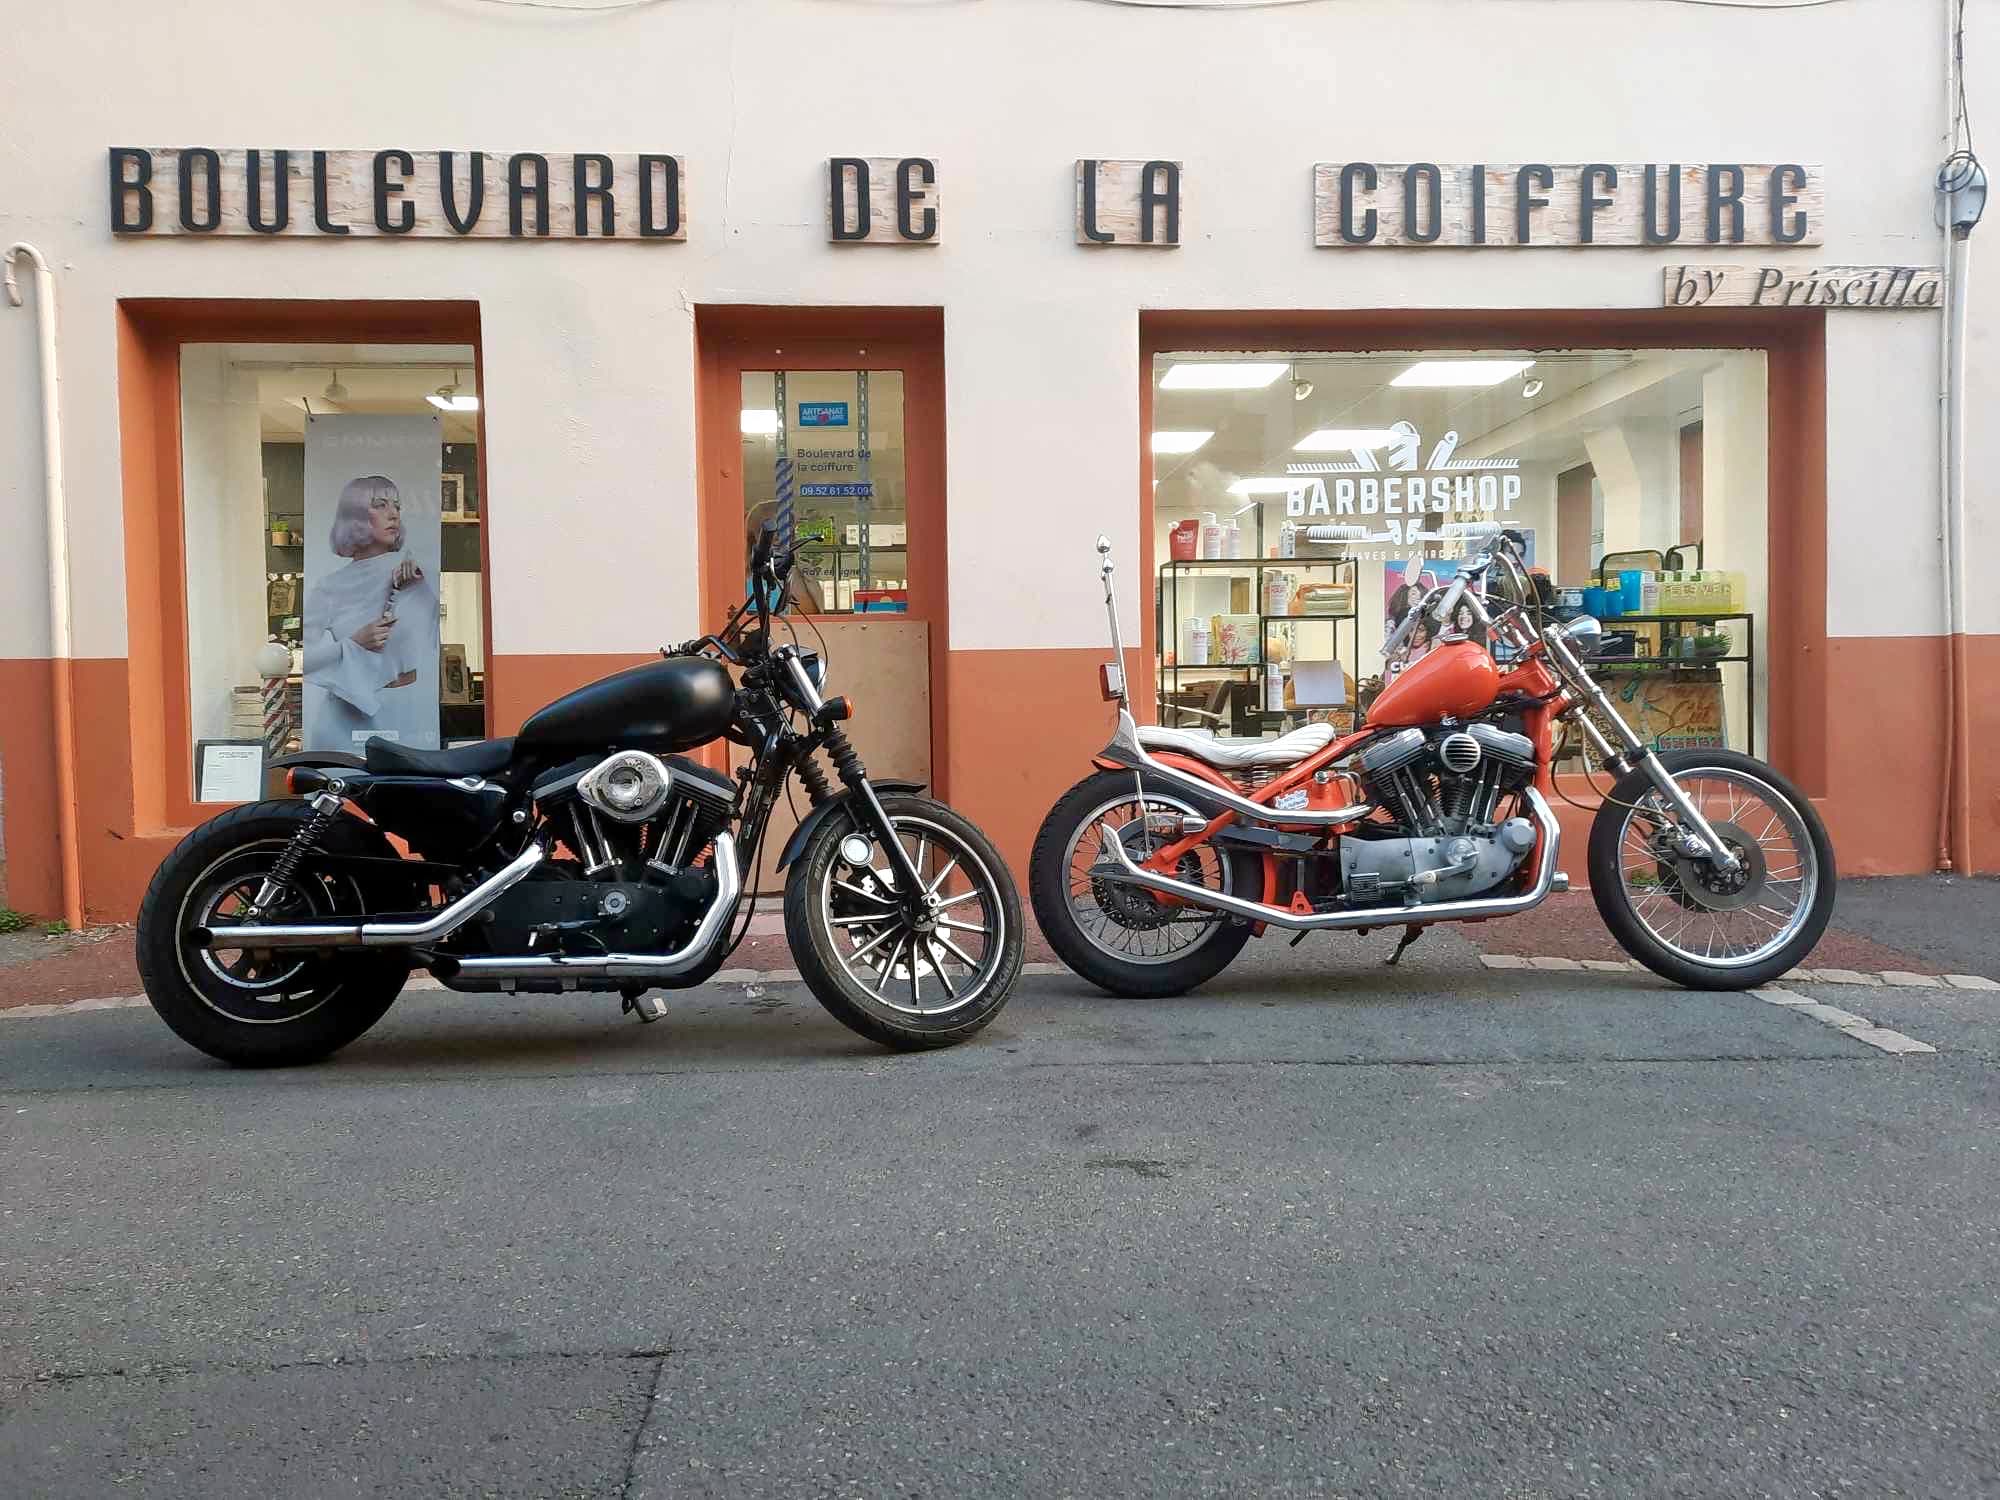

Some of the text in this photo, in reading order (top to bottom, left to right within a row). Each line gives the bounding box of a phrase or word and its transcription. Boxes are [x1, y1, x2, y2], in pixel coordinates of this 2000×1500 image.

[108, 147, 1807, 244] BOULEVARD DE LA COIFFURE
[1674, 265, 1939, 306] by Priscilla
[797, 448, 871, 458] Boulevard de
[797, 462, 857, 472] la coiffure
[1286, 475, 1521, 516] BARBERSHOP
